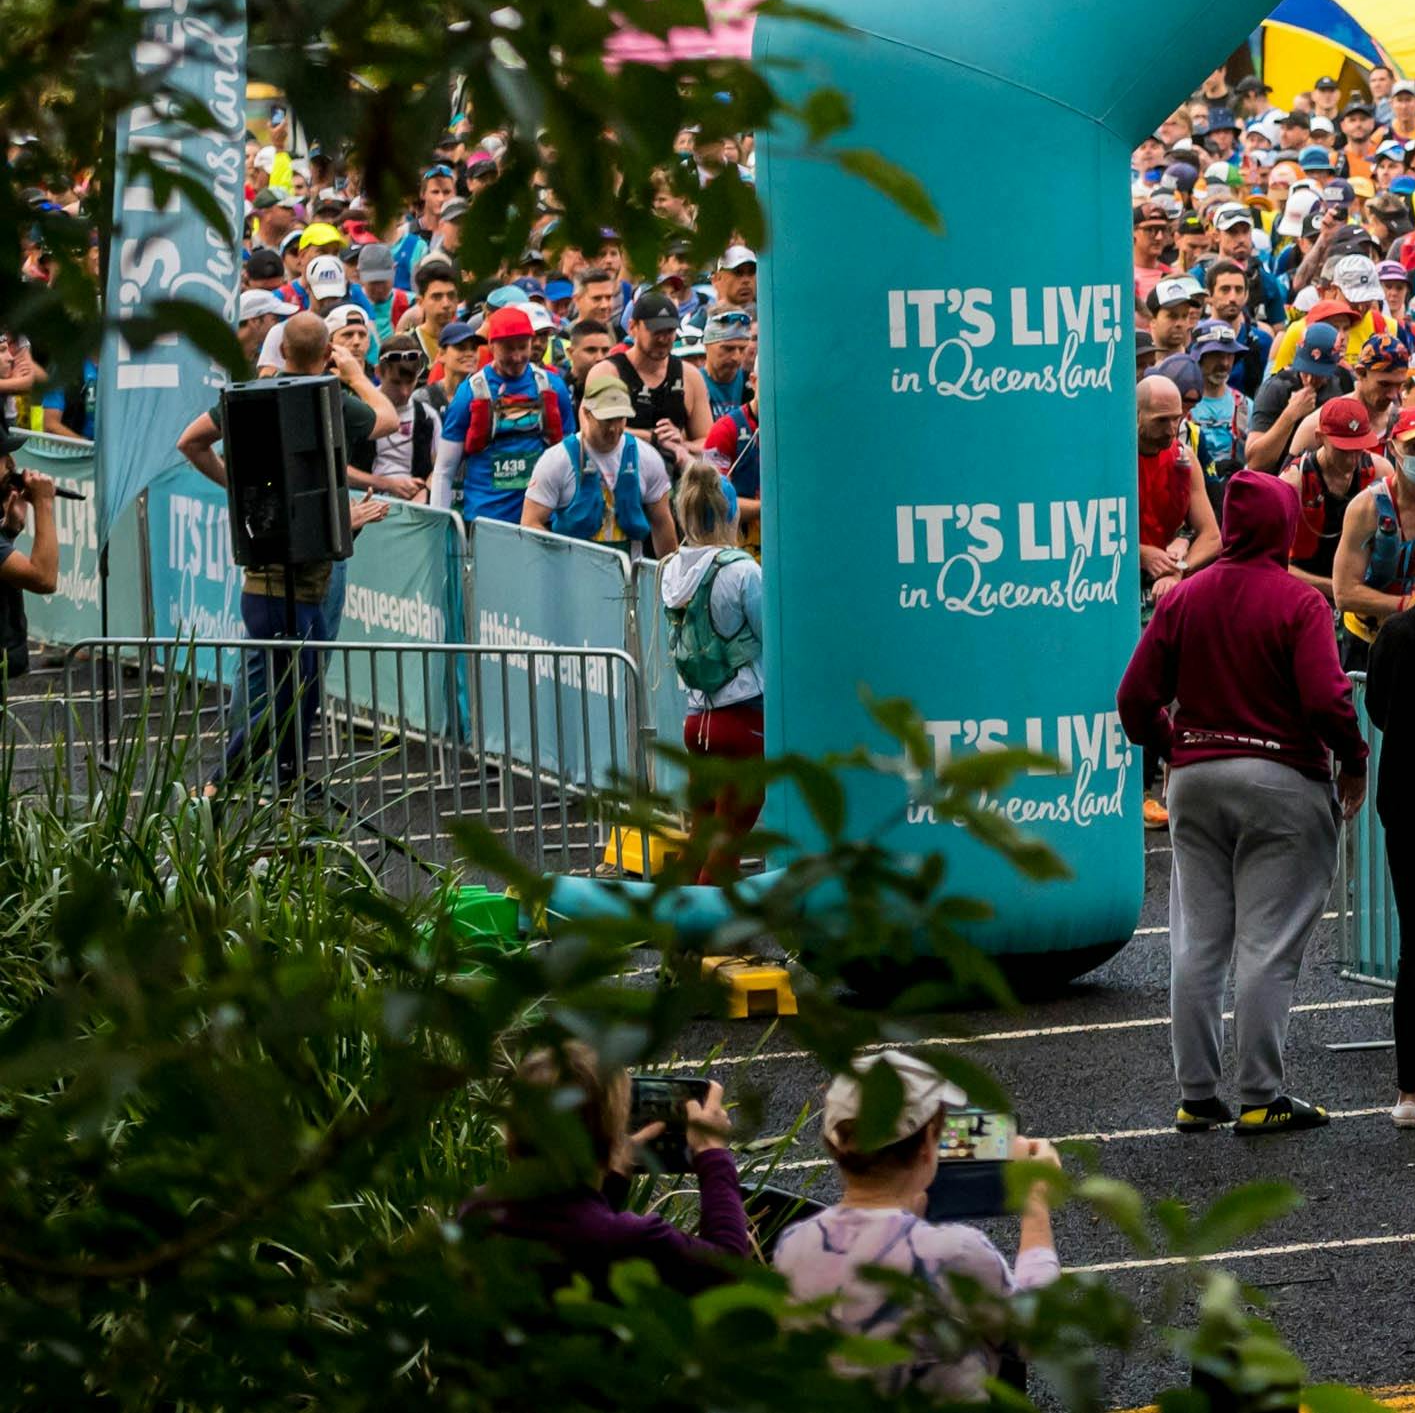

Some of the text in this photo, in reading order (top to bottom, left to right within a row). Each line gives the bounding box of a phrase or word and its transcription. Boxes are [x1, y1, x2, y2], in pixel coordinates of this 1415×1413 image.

[887, 284, 1123, 348] IT'S LIVE!
[891, 331, 1113, 401] in Queensland
[494, 459, 526, 472] 1438
[169, 493, 204, 577] IT'S
[896, 497, 1127, 564] IT'S LIVE!
[900, 548, 1119, 616] in Queensland
[907, 757, 1127, 827] in ueensland
